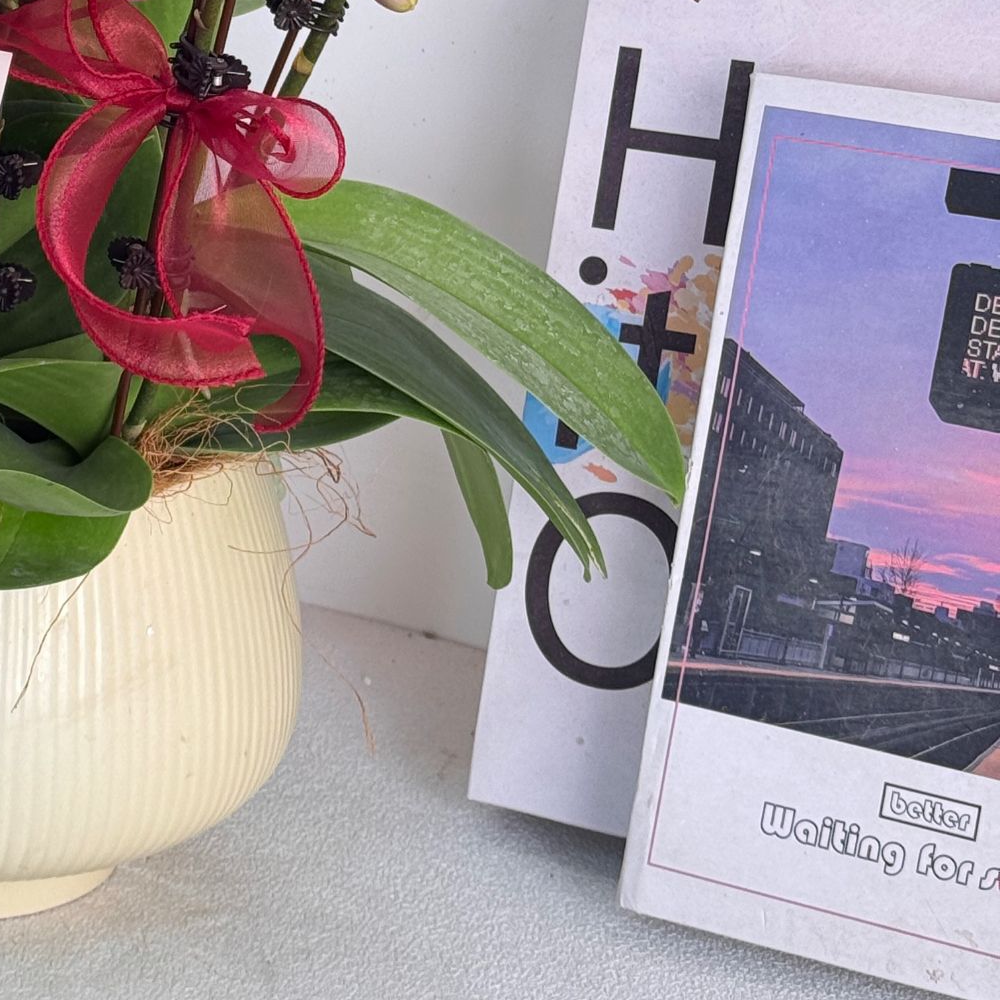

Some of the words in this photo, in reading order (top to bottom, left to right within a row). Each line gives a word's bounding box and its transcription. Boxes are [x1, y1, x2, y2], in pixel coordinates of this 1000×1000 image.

[889, 790, 971, 832] better
[760, 801, 906, 876] Waiting
[916, 843, 975, 885] for
